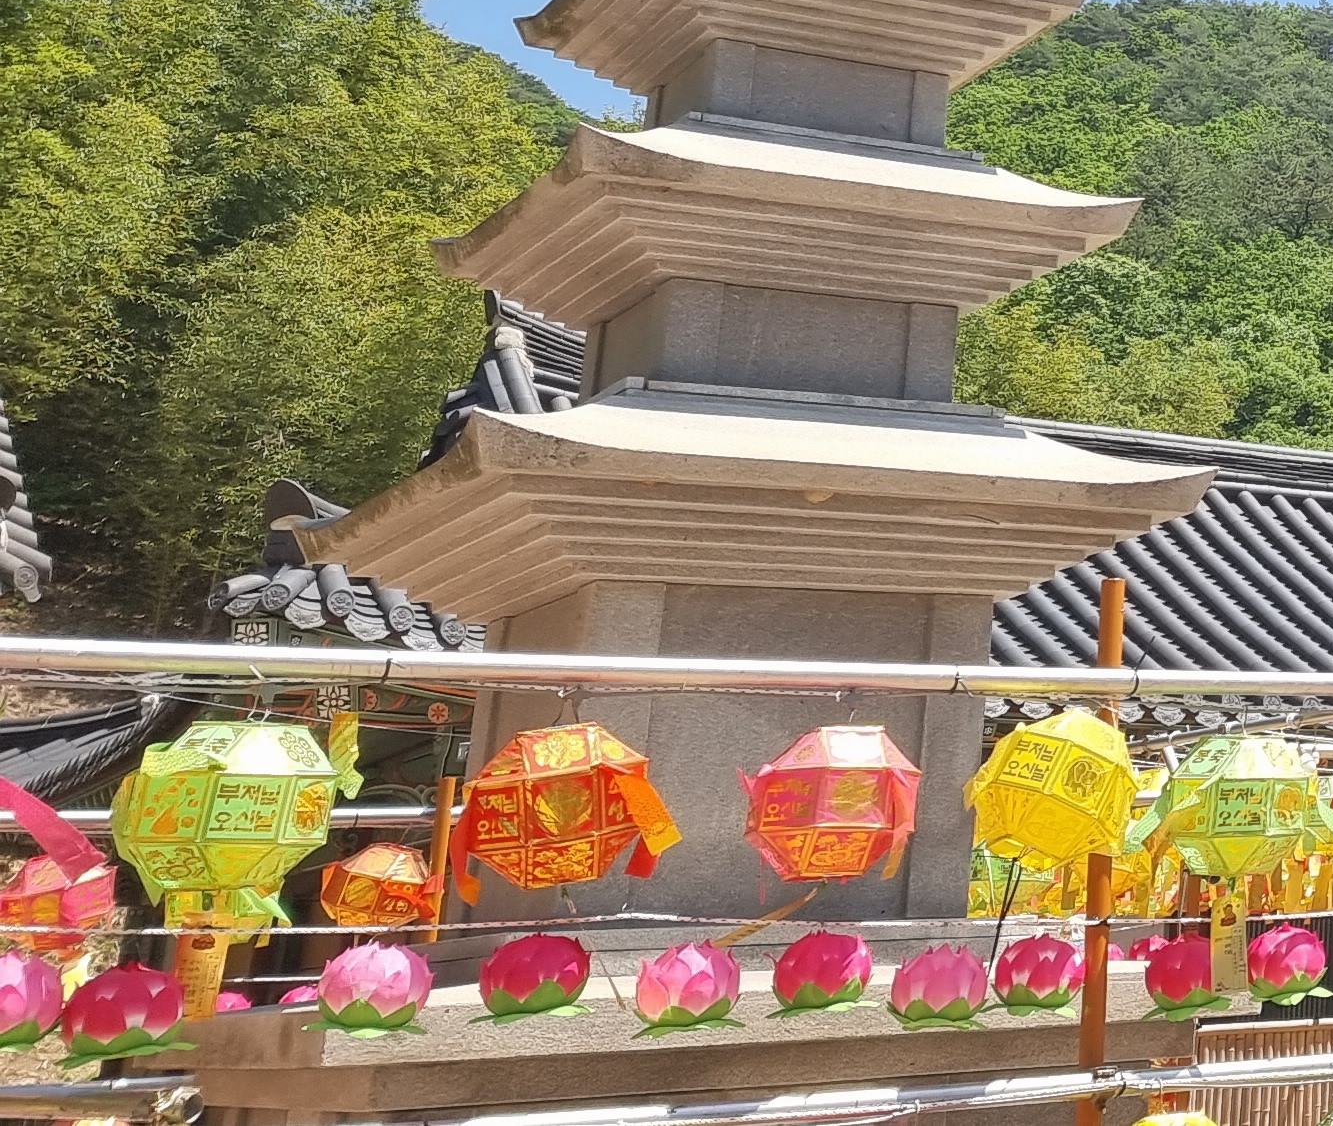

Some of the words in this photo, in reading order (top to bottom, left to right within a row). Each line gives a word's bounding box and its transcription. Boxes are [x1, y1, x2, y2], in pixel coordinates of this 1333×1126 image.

[1015, 739, 1059, 762] 부처님
[1002, 760, 1050, 783] 오신날
[216, 782, 282, 806] 부처님
[1218, 786, 1263, 805] 부처님
[209, 810, 276, 833] 오신날
[1218, 810, 1262, 827] 오신날
